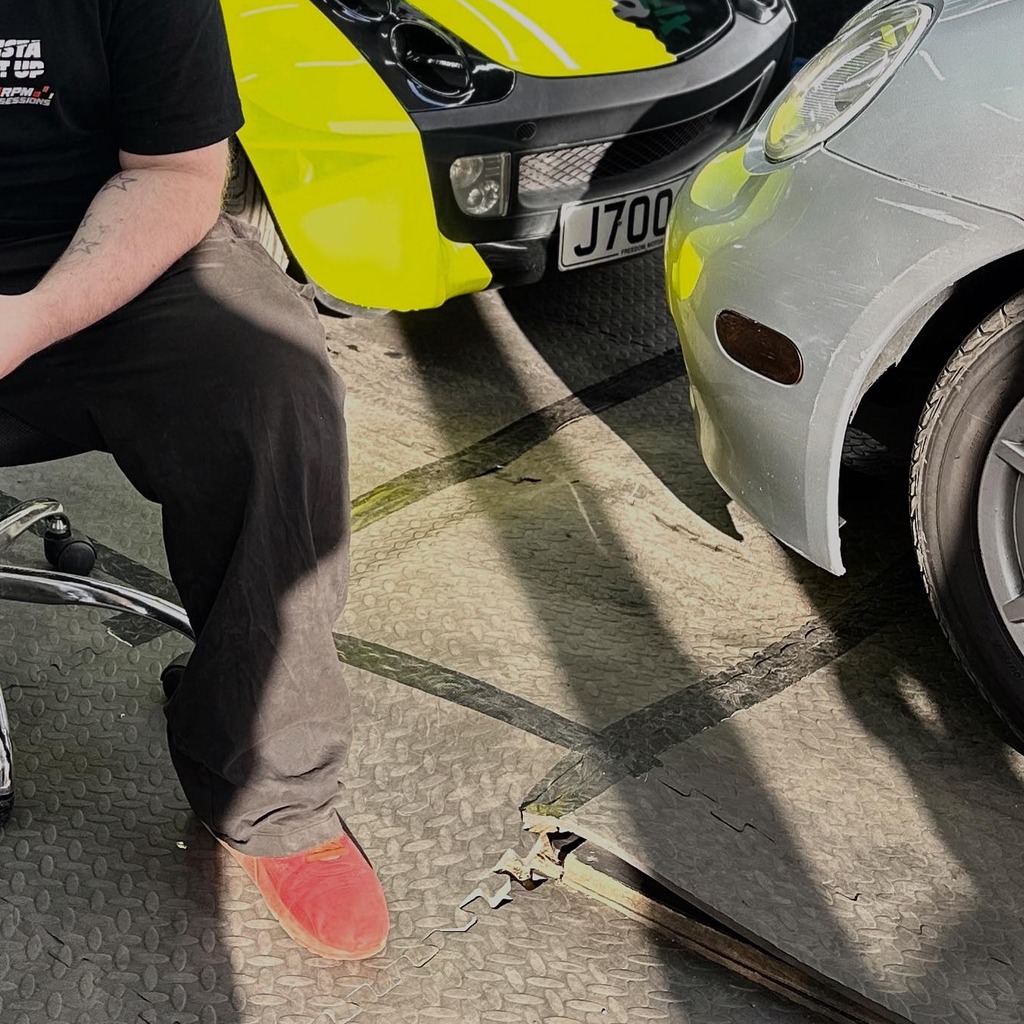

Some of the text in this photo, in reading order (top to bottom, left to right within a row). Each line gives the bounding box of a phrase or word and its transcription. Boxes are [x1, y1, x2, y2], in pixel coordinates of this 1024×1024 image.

[14, 60, 45, 78] UP
[0, 87, 34, 97] RPM
[574, 188, 673, 257] J700
